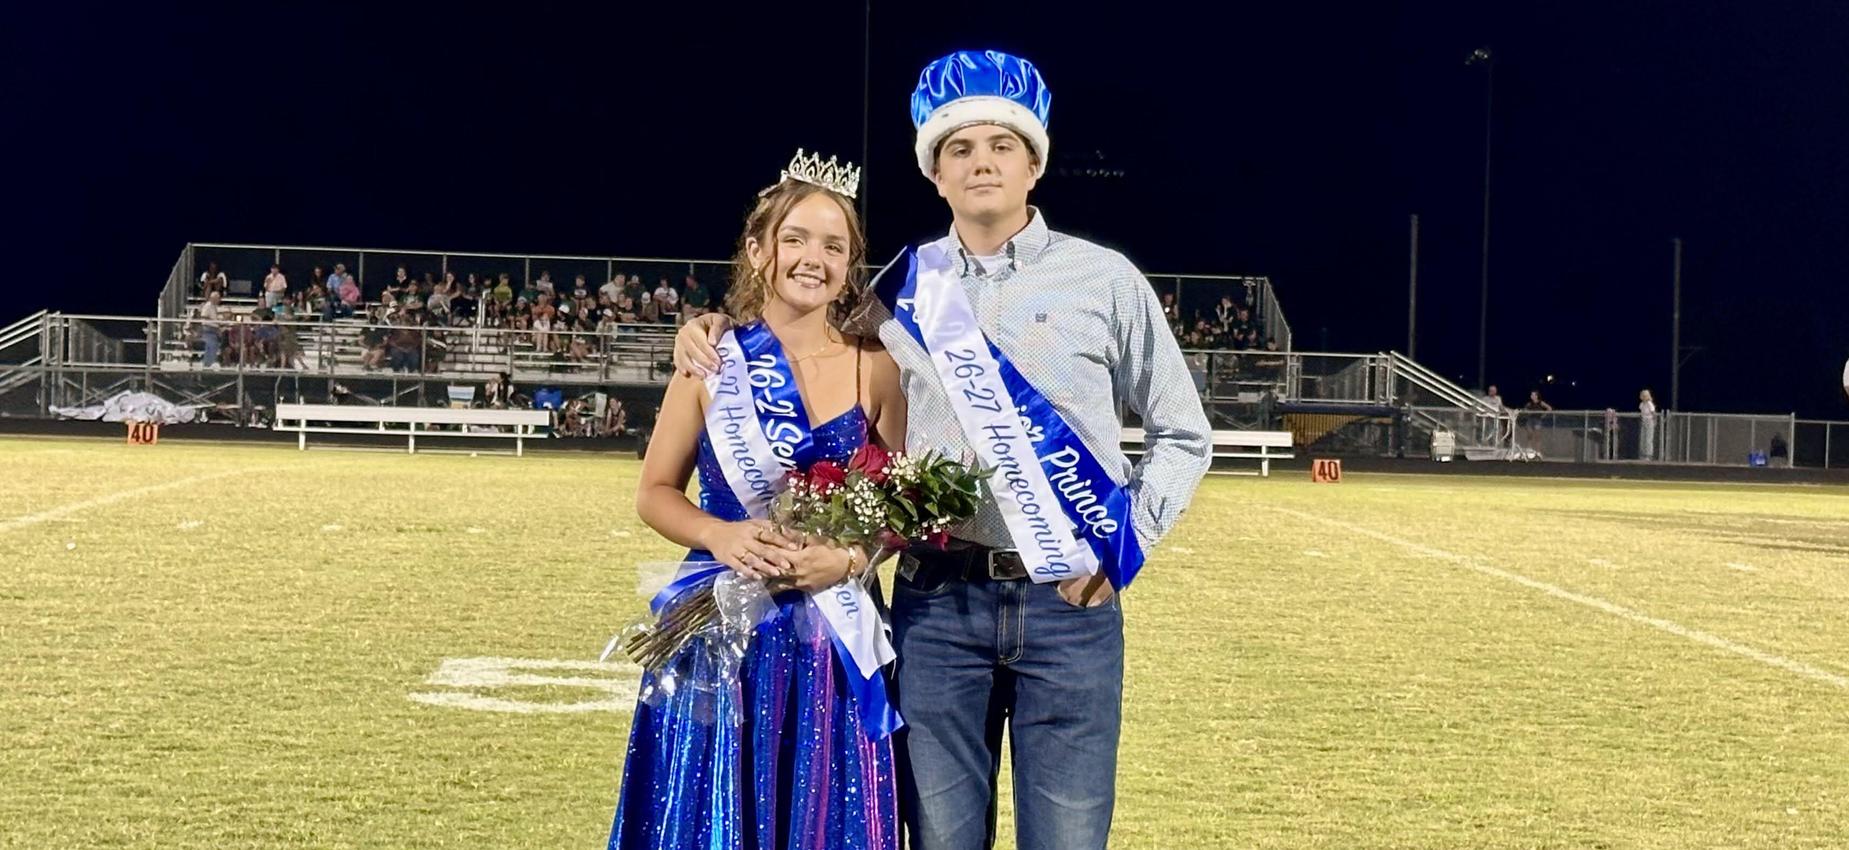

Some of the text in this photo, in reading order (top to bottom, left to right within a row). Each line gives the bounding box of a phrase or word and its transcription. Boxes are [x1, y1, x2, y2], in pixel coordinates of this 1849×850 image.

[131, 421, 154, 443] 40
[944, 349, 1072, 578] 26-27 Homecoming
[1038, 445, 1119, 539] Prince
[1318, 460, 1339, 480] 40
